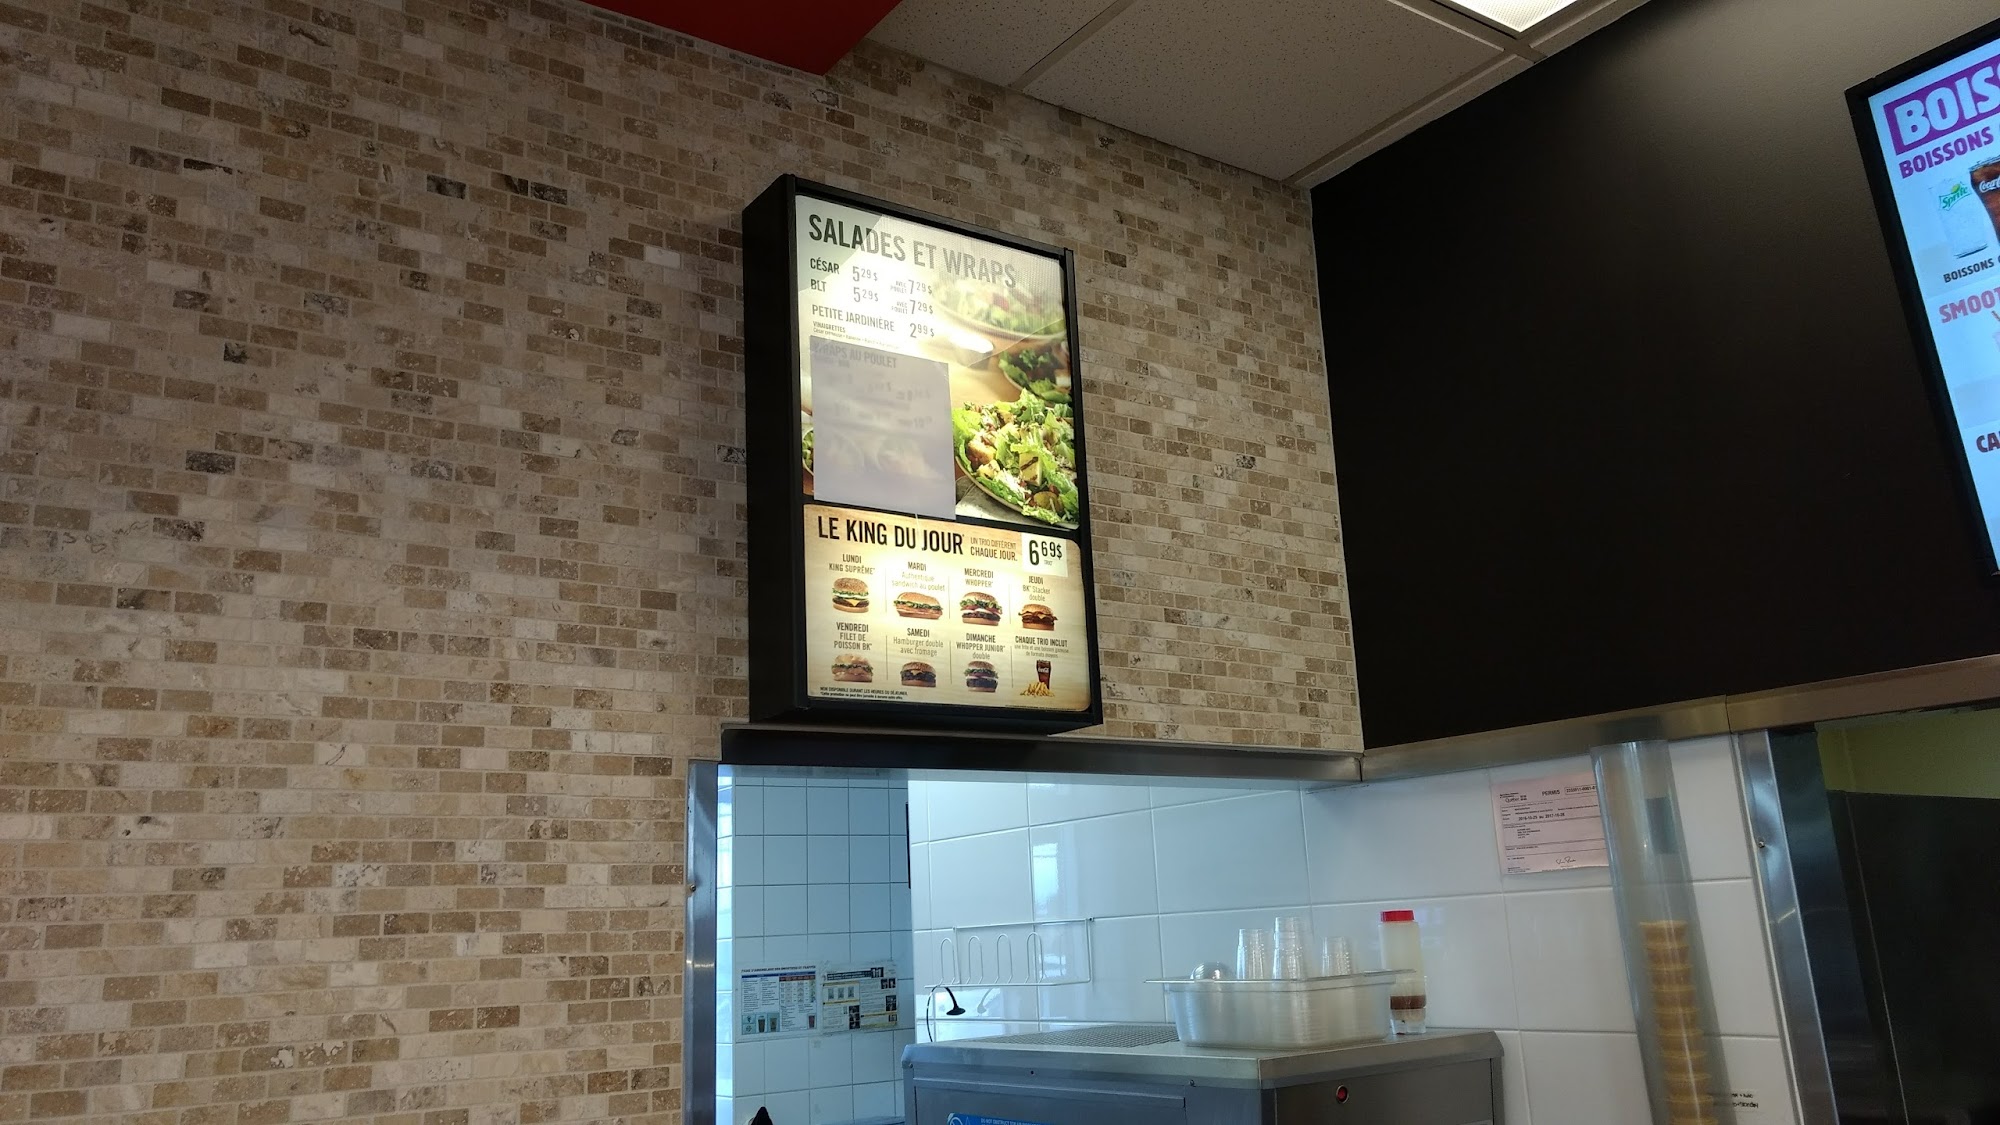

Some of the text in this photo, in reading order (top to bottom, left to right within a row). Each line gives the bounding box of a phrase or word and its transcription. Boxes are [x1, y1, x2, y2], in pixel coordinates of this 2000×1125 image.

[1894, 62, 2000, 146] BOIS
[1899, 126, 1994, 179] BOISSONS
[1942, 186, 1967, 209] Sprite
[809, 214, 1016, 288] SALADES ET WRAPS
[810, 257, 839, 274] CÉSAR
[1943, 258, 1994, 283] BOISSONS
[811, 279, 826, 292] BLT
[812, 305, 843, 321] PETITE
[846, 312, 895, 332] JARDINIÈRE
[813, 321, 846, 333] VINAIGRETTES
[1976, 430, 2000, 453] CA
[818, 516, 840, 540] LE
[846, 519, 887, 546] KING
[895, 526, 916, 549] DU
[971, 537, 1017, 550] UN TRIO DIFFÉRENT
[971, 546, 998, 559] CHAQUE
[843, 554, 862, 564] LUNDI
[829, 563, 844, 572] KING
[908, 562, 927, 571] MARDI
[964, 568, 994, 579] MERCREDI
[1029, 576, 1044, 585] JEUDI
[928, 584, 945, 592] poulet
[1033, 586, 1051, 594] Stacker
[1030, 594, 1046, 602] double
[837, 622, 869, 633] VENDREDI
[907, 628, 930, 638] SAMEDI
[840, 632, 866, 642] FILET DE
[894, 637, 944, 648] Hamburger double
[966, 633, 996, 644] DIMANCHE
[1015, 636, 1036, 645] CHAQUE
[1037, 638, 1049, 646] TRIO
[834, 641, 861, 651] POISSON
[956, 642, 984, 651] WHOPPER
[915, 647, 938, 657] fromage
[973, 652, 991, 660] double
